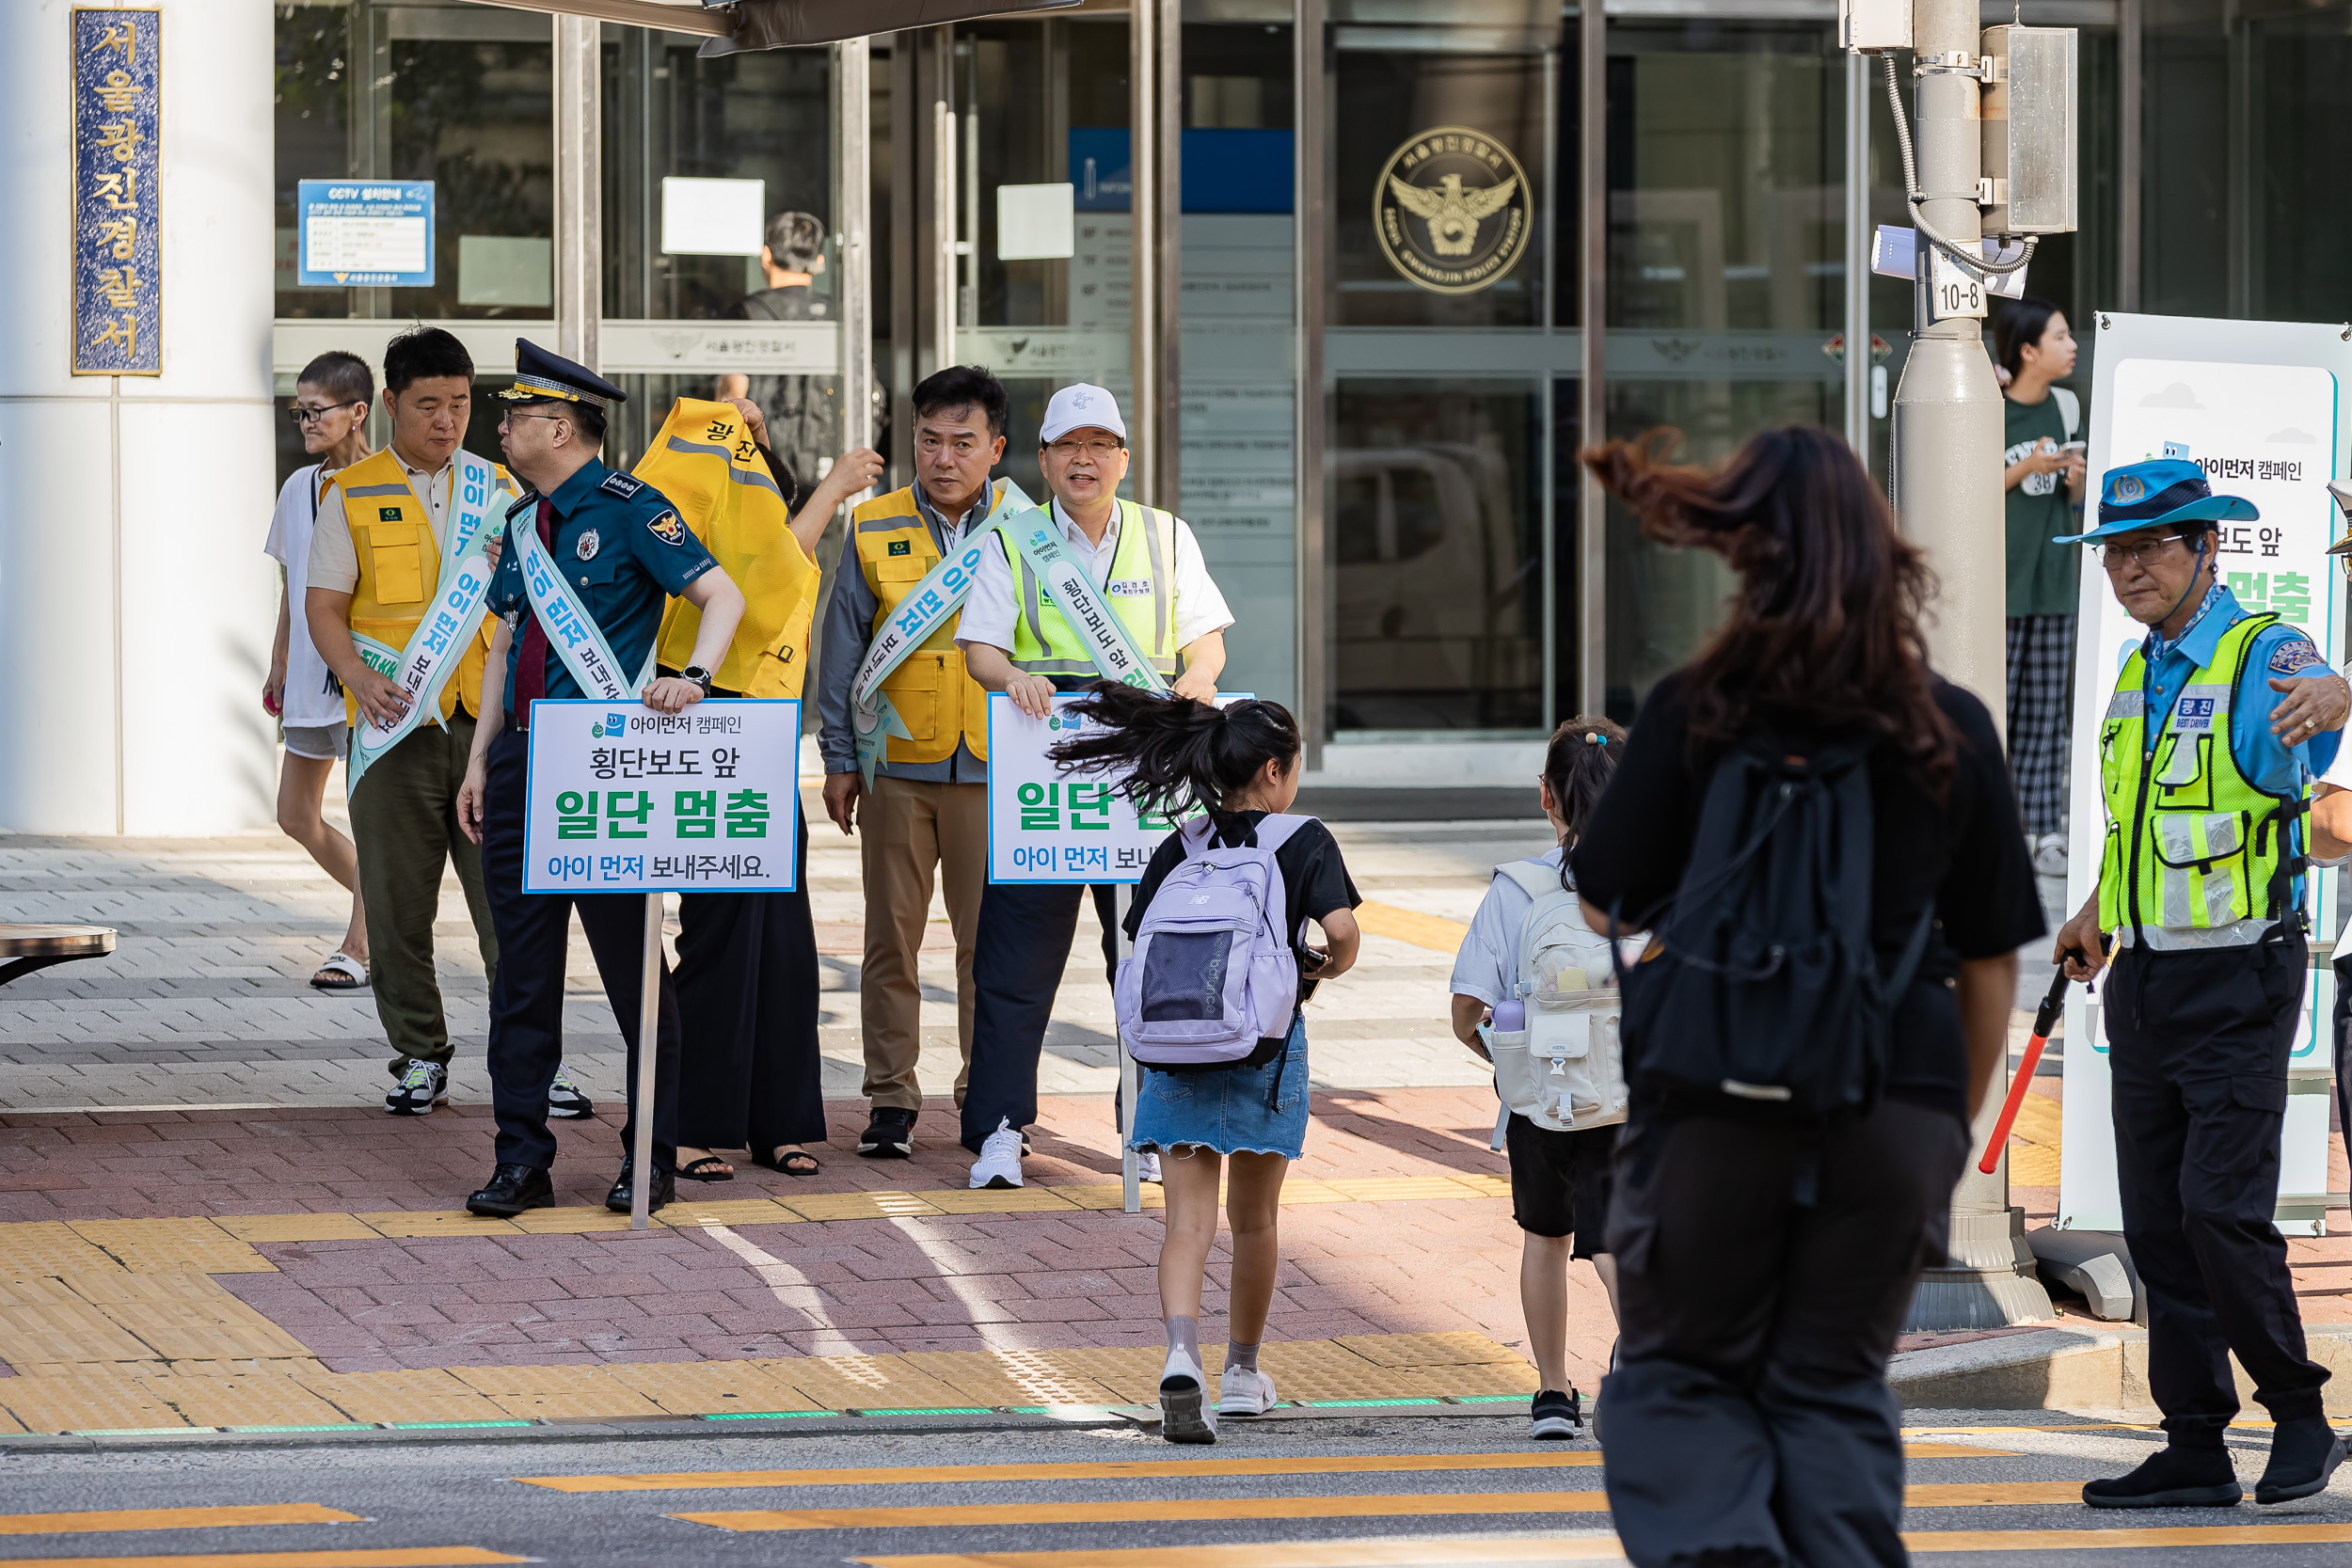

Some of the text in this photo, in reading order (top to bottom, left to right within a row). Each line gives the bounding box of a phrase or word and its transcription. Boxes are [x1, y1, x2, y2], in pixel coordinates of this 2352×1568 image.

[91, 21, 143, 359] 서울광진경찰서
[328, 187, 359, 199] CCTV
[1400, 249, 1463, 282] GWANGJIN
[1463, 255, 1502, 280] POLICE
[1497, 207, 1523, 258] STATION
[1941, 282, 1979, 310] 10-8
[464, 465, 485, 507] 아이
[2258, 460, 2301, 482] 캠페인
[1033, 541, 1058, 556] 아이먼저
[1041, 549, 1061, 562] 캠페인
[2259, 527, 2282, 557] 앞
[448, 573, 481, 615] 아이
[2227, 572, 2311, 624] 멈춤
[526, 547, 621, 699] 아이 먼저 보내주
[895, 589, 945, 638] 먼저
[422, 610, 459, 657] 먼저
[1061, 578, 1152, 690] 횡단보도 앞 일
[2176, 718, 2189, 728] BEST
[2182, 699, 2211, 715] 광진
[630, 716, 741, 735] 아이먼저 캠페인
[589, 747, 740, 779] 횡단보도 앞
[556, 788, 770, 839] 일단 멈춤
[1017, 782, 1115, 831] 일단
[548, 854, 771, 881] 아이 먼저 보내주세요.
[1013, 847, 1057, 872] 아이
[1065, 847, 1107, 872] 먼저
